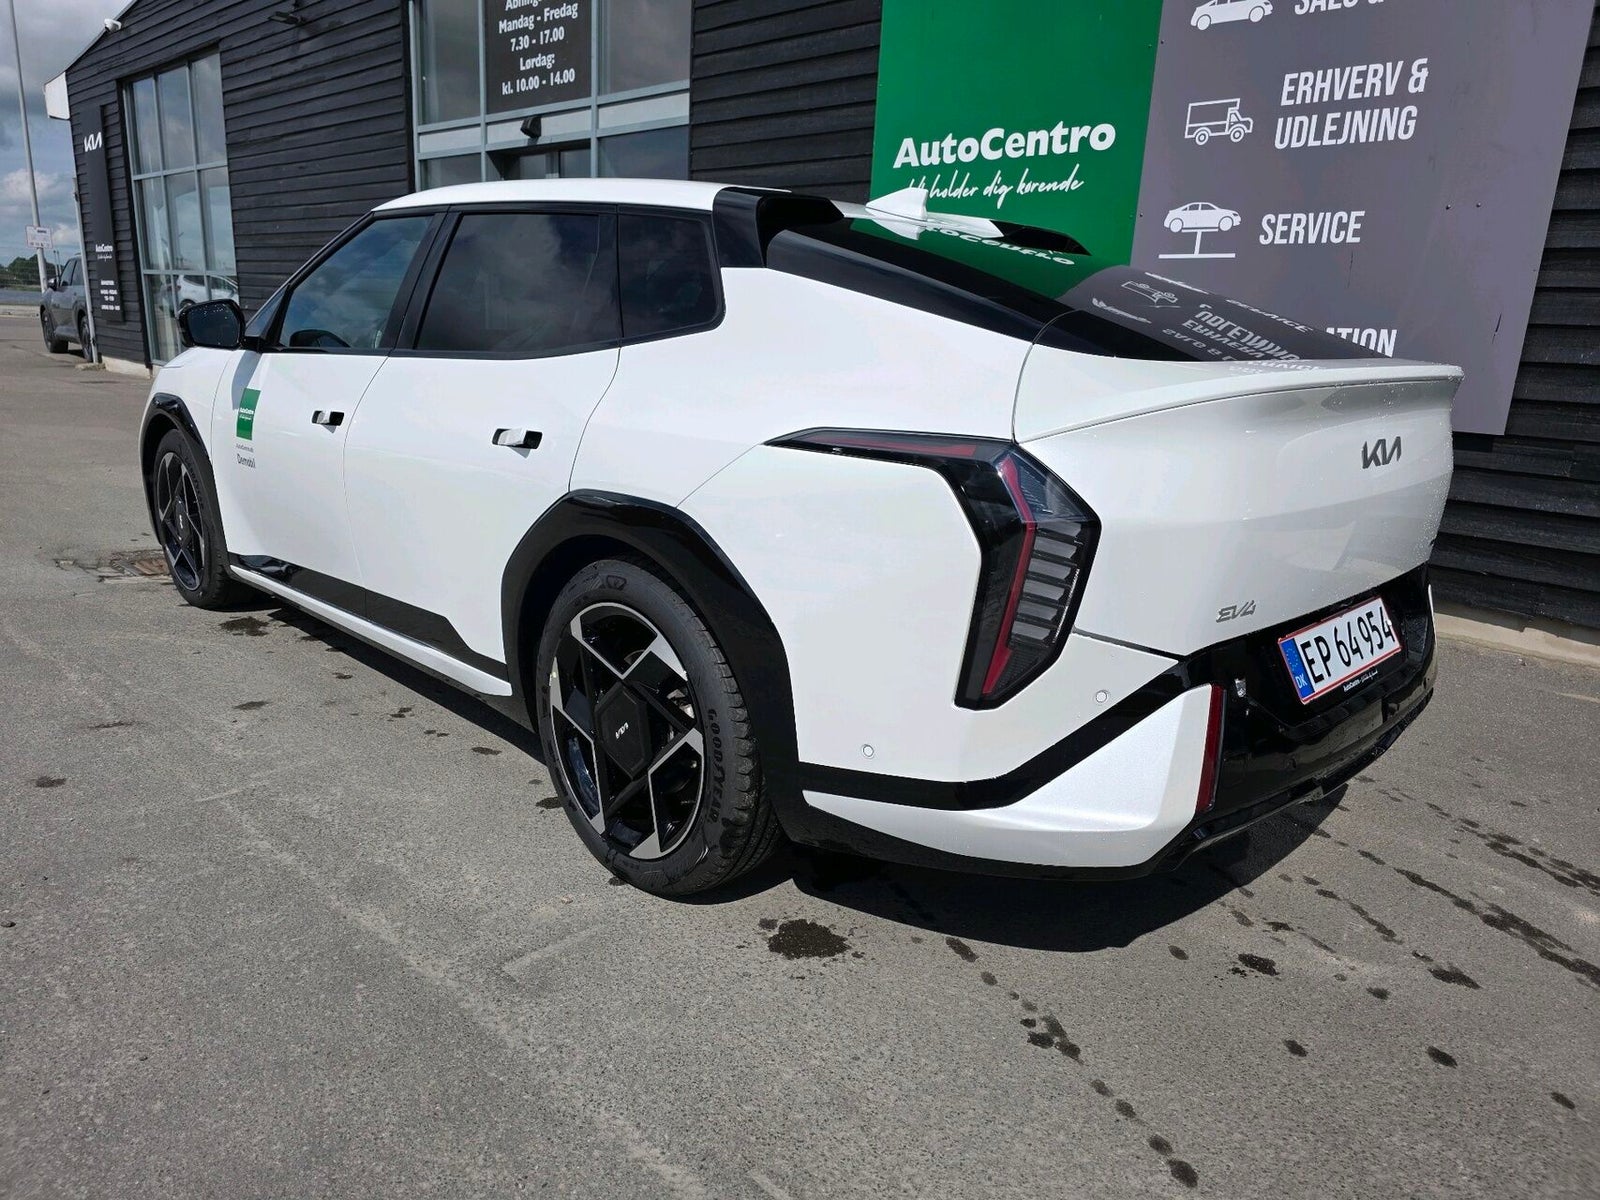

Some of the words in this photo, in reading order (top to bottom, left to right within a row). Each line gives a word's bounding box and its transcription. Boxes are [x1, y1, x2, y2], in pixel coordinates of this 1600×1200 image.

[498, 15, 535, 34] Mandag
[543, 3, 578, 22] Fredag
[510, 35, 530, 52] 7.30
[540, 26, 565, 45] 17.00
[520, 53, 555, 70] Lørdag:
[502, 81, 513, 95] kl.
[516, 75, 540, 92] 10.00
[550, 68, 575, 86] 14.00
[1281, 61, 1403, 106] ERHVERV
[1408, 58, 1429, 93] &
[893, 121, 1116, 168] AutoCentro
[1275, 106, 1417, 150] UDLEJNING
[929, 169, 978, 199] holder
[983, 170, 1013, 209] dig
[1259, 211, 1365, 245] SERVICE
[1362, 436, 1402, 469] KIA
[1216, 600, 1256, 623] EV4
[1300, 635, 1332, 684] EP
[1333, 606, 1396, 667] 64954
[1294, 673, 1308, 689] DK
